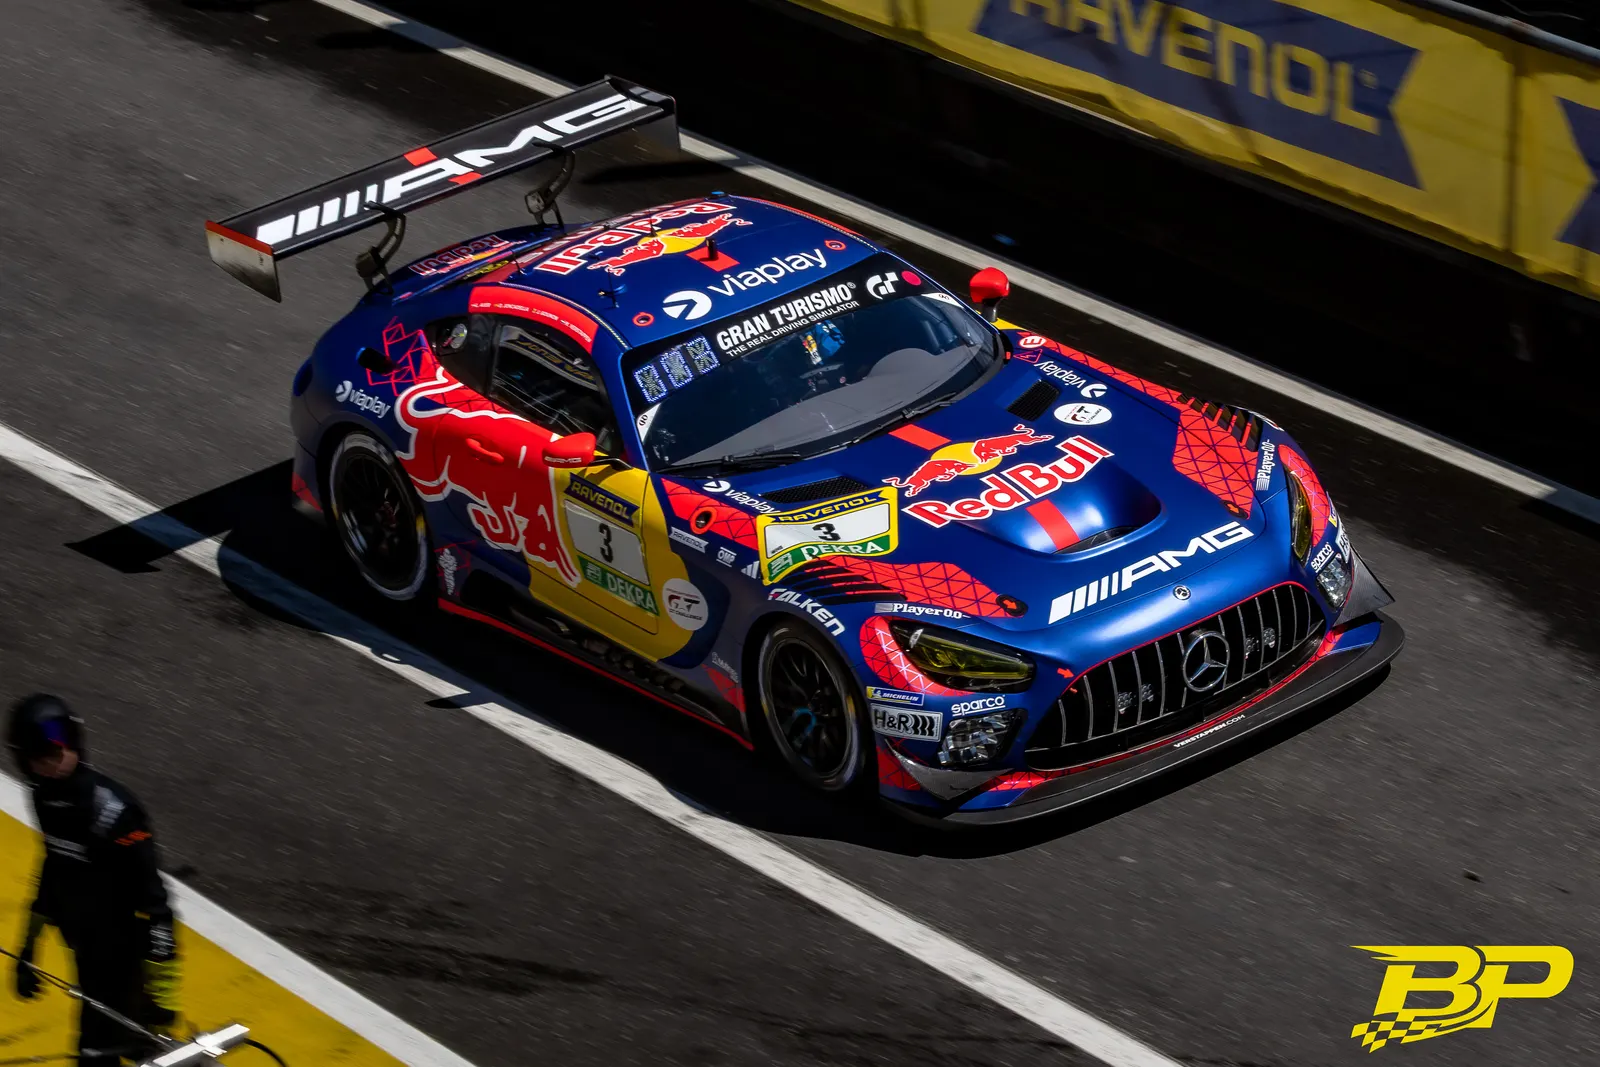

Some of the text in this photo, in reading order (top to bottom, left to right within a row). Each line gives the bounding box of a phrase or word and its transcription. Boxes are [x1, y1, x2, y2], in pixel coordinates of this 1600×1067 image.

[382, 94, 647, 204] AMG
[707, 247, 829, 298] viaplay
[716, 313, 772, 351] GRAN
[726, 300, 860, 357] THE REAL DRIVING SIMULATOR
[1033, 361, 1087, 388] viaplay
[350, 388, 391, 419] viaplay
[571, 480, 631, 521] RAVENOL
[724, 488, 780, 514] viaplay
[778, 495, 878, 522] RAVENOL
[598, 522, 614, 564] 3
[672, 530, 705, 550] RAVENOL
[812, 522, 841, 542] 3
[717, 549, 736, 566] OMP
[800, 541, 885, 562] DEKRA
[1122, 521, 1254, 591] AMG
[1310, 543, 1333, 570] sparco
[606, 572, 658, 614] DEKRA
[768, 588, 846, 638] FALKEN
[892, 602, 944, 617] Player
[882, 691, 920, 703] MICHELIN
[951, 696, 1005, 716] sparco
[874, 709, 911, 732] H&R
[1173, 713, 1247, 749] VERSTAPPEN.COM
